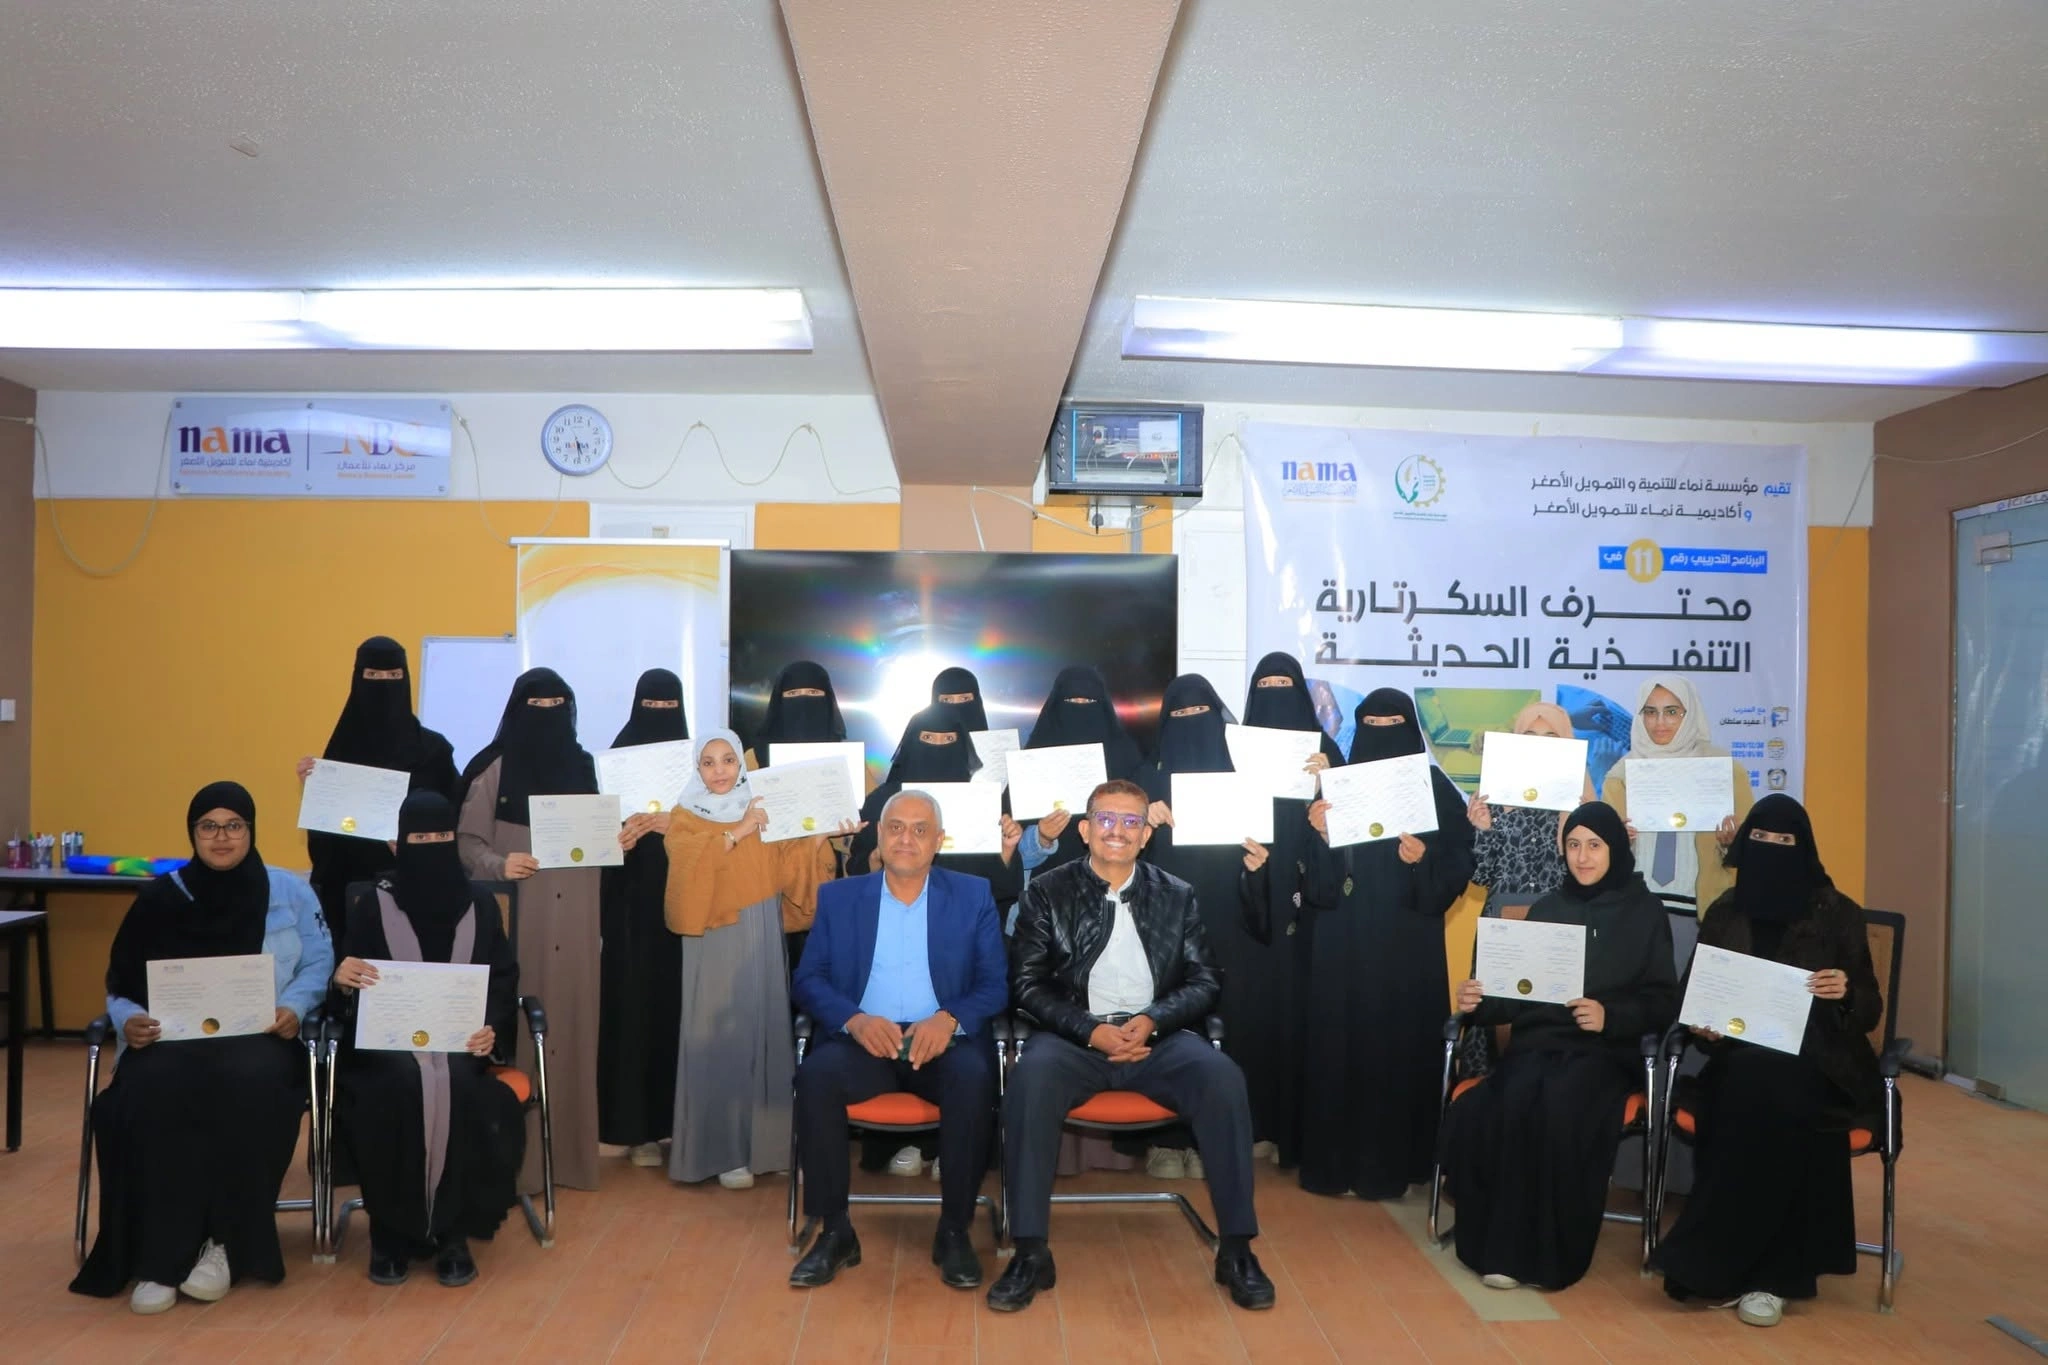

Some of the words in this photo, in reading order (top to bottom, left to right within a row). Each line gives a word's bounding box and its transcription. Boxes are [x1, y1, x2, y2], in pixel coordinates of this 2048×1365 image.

[178, 426, 292, 454] nama
[341, 420, 422, 457] NBC
[1281, 461, 1357, 482] nama
[1531, 471, 1573, 490] الأصغر
[1575, 476, 1626, 492] التمويل
[1638, 477, 1677, 492] للتنمية
[1679, 478, 1703, 491] نماء
[1705, 477, 1758, 496] مؤسسة
[1763, 482, 1791, 497] تقيم
[1533, 497, 1580, 516] الأصغر
[1582, 502, 1637, 518] للتمويل
[1641, 503, 1673, 517] نماء
[1675, 501, 1742, 520] أكاديمية
[1603, 551, 1623, 562] في
[1632, 547, 1654, 576] 11
[1670, 553, 1688, 566] رقم
[1691, 554, 1731, 566] التدريبي
[1731, 554, 1765, 568] البرنامج
[1316, 579, 1527, 625] السكرتارية
[1541, 585, 1752, 628] محترف
[1315, 627, 1530, 677] الحديثة
